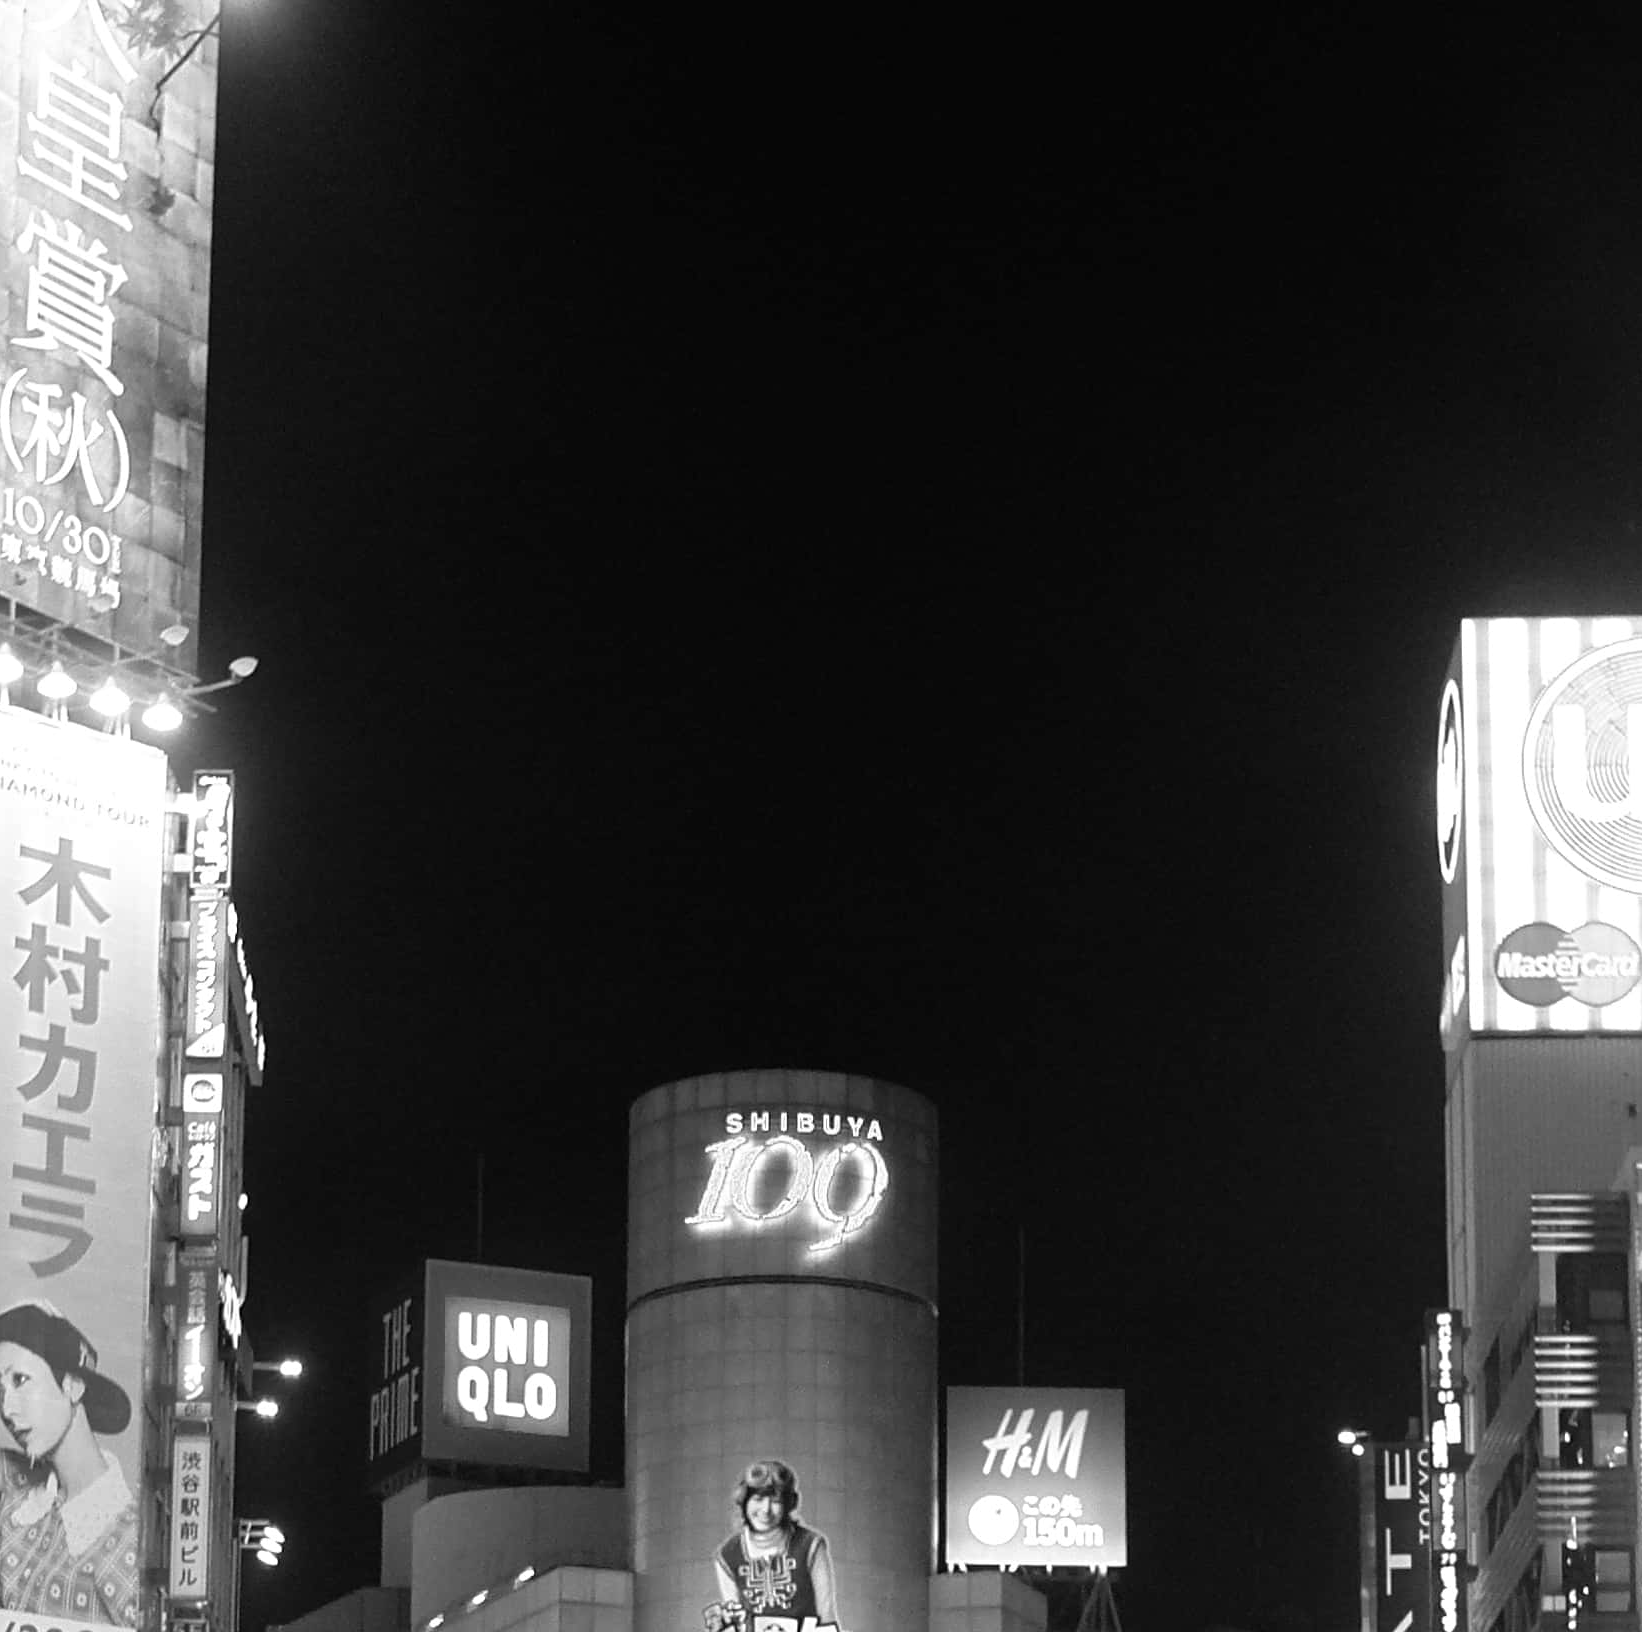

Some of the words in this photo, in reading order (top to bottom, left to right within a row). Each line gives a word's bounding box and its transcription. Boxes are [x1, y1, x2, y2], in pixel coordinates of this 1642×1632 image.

[1497, 948, 1641, 983] MasterCard
[11, 836, 114, 1281] 木村カエラ
[725, 1111, 885, 1142] SHIBUYA
[684, 1133, 892, 1253] 109
[381, 1295, 413, 1371] THE
[457, 1310, 551, 1367] UNI
[369, 1363, 421, 1463] PRIME
[456, 1365, 558, 1422] QLO
[981, 1406, 1091, 1480] H&M
[179, 1451, 201, 1587] 渋谷駅前ビル
[1022, 1493, 1084, 1519] この先
[1022, 1517, 1106, 1549] 150m
[1418, 1446, 1432, 1546] TOKYO
